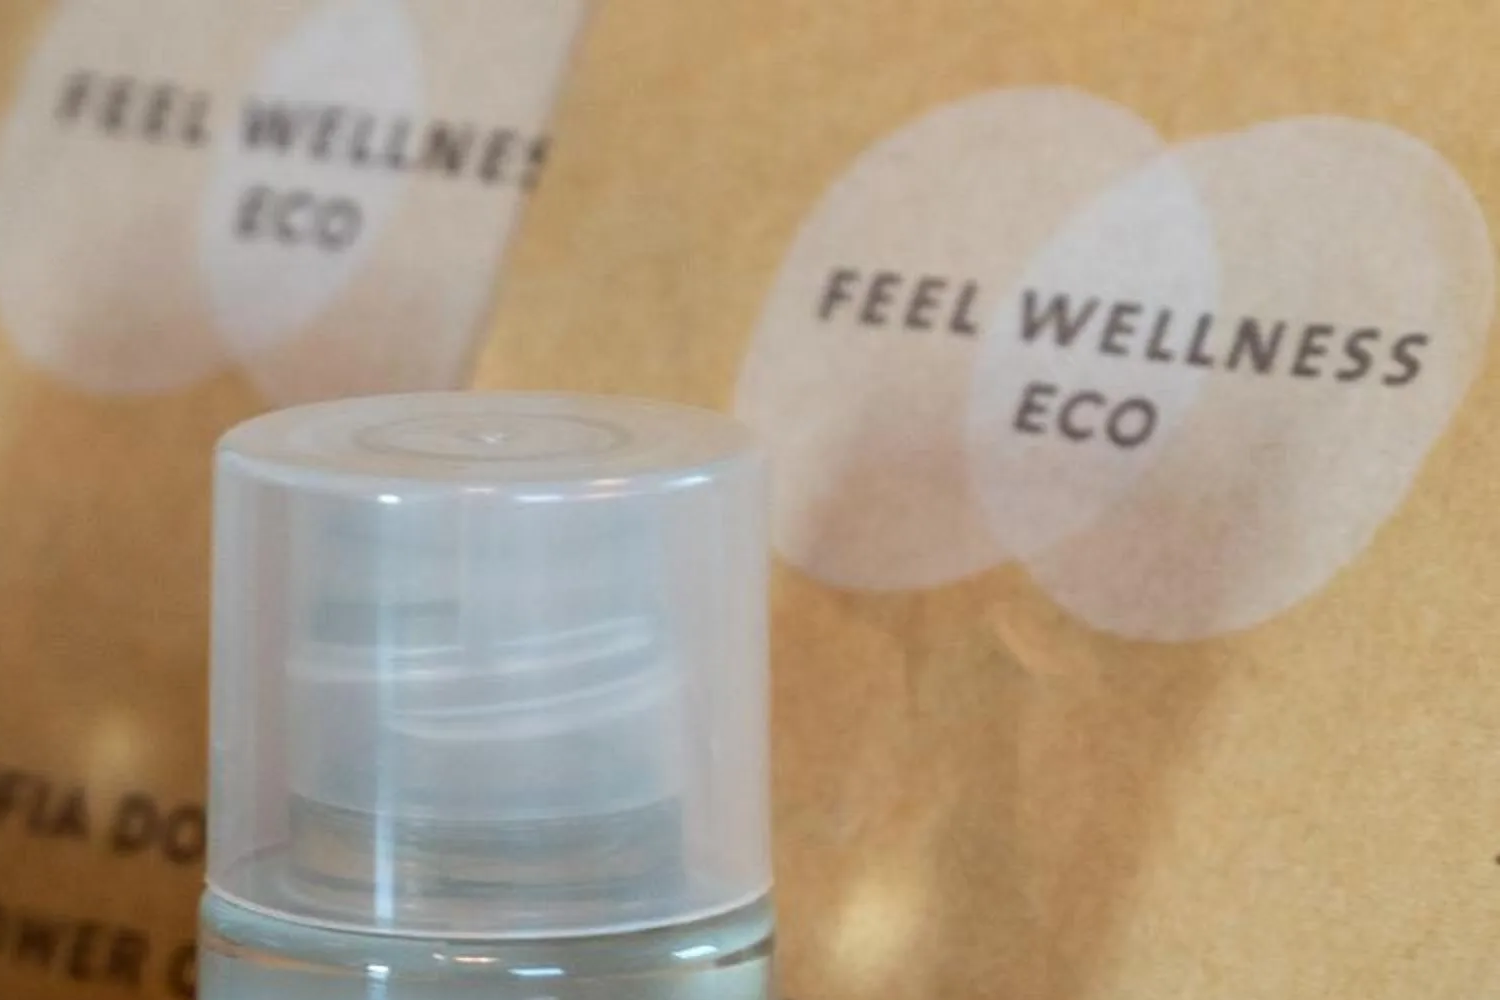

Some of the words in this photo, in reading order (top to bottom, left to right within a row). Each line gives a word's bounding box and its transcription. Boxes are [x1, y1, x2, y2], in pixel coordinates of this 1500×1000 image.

[54, 69, 211, 148] FEEL
[233, 185, 363, 251] ECO
[817, 269, 980, 337] FEEL
[1018, 289, 1430, 386] WELLNESS
[1011, 382, 1159, 448] ECO
